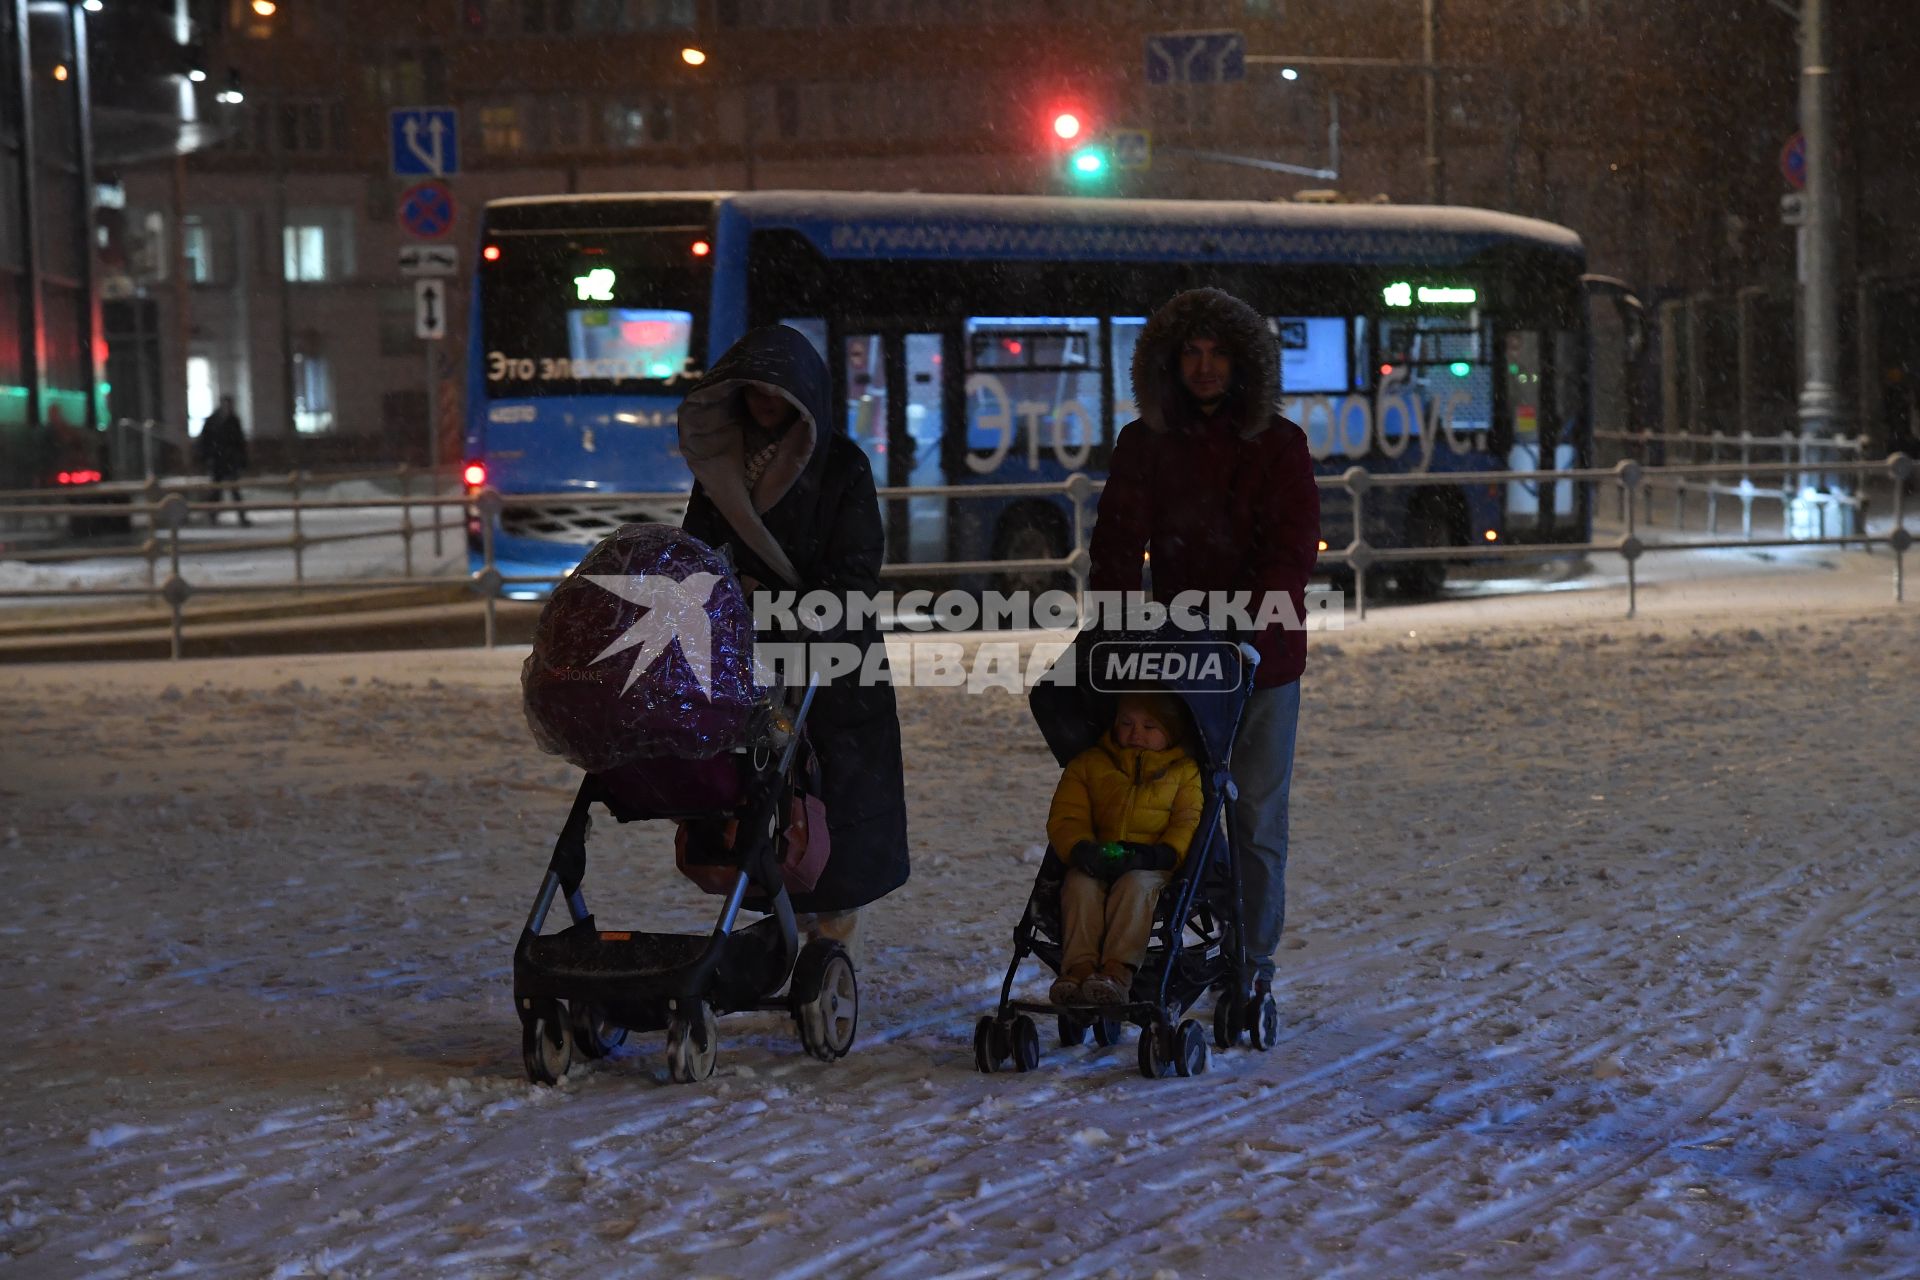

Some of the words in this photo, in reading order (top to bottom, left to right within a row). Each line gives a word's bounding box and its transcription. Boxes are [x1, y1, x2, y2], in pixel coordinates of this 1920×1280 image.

[486, 350, 536, 381] Это
[539, 354, 703, 387] электроус.
[965, 373, 1091, 473] Это
[560, 669, 602, 681] STOKKE
